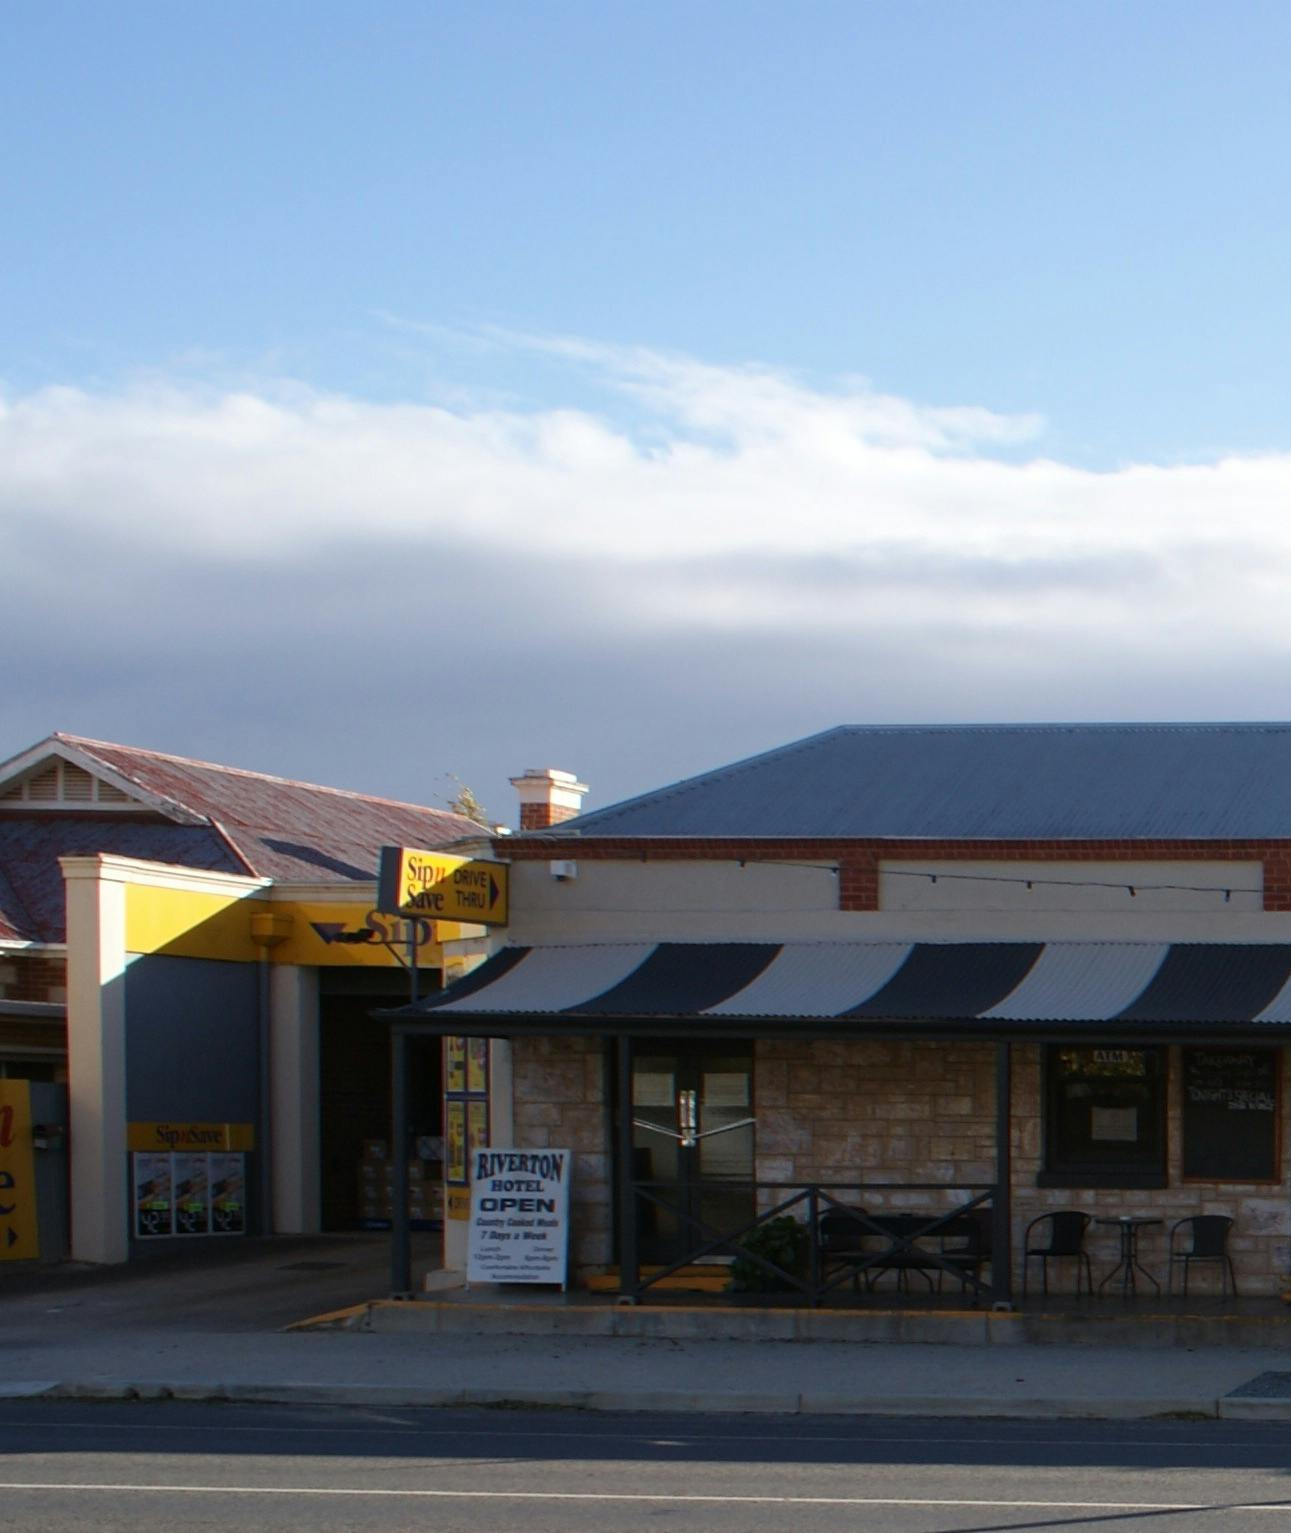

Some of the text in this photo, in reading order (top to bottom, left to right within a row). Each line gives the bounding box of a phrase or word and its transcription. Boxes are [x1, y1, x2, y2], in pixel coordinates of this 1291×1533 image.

[454, 869, 488, 888] DRIVE
[407, 883, 444, 911] Save
[456, 890, 486, 908] THRU
[477, 1152, 563, 1183] RIVERTON
[491, 1180, 545, 1192] HOTEL
[480, 1198, 556, 1212] OPEN
[481, 1231, 488, 1240] 7
[489, 1231, 511, 1241] Days
[522, 1231, 547, 1240] Week
